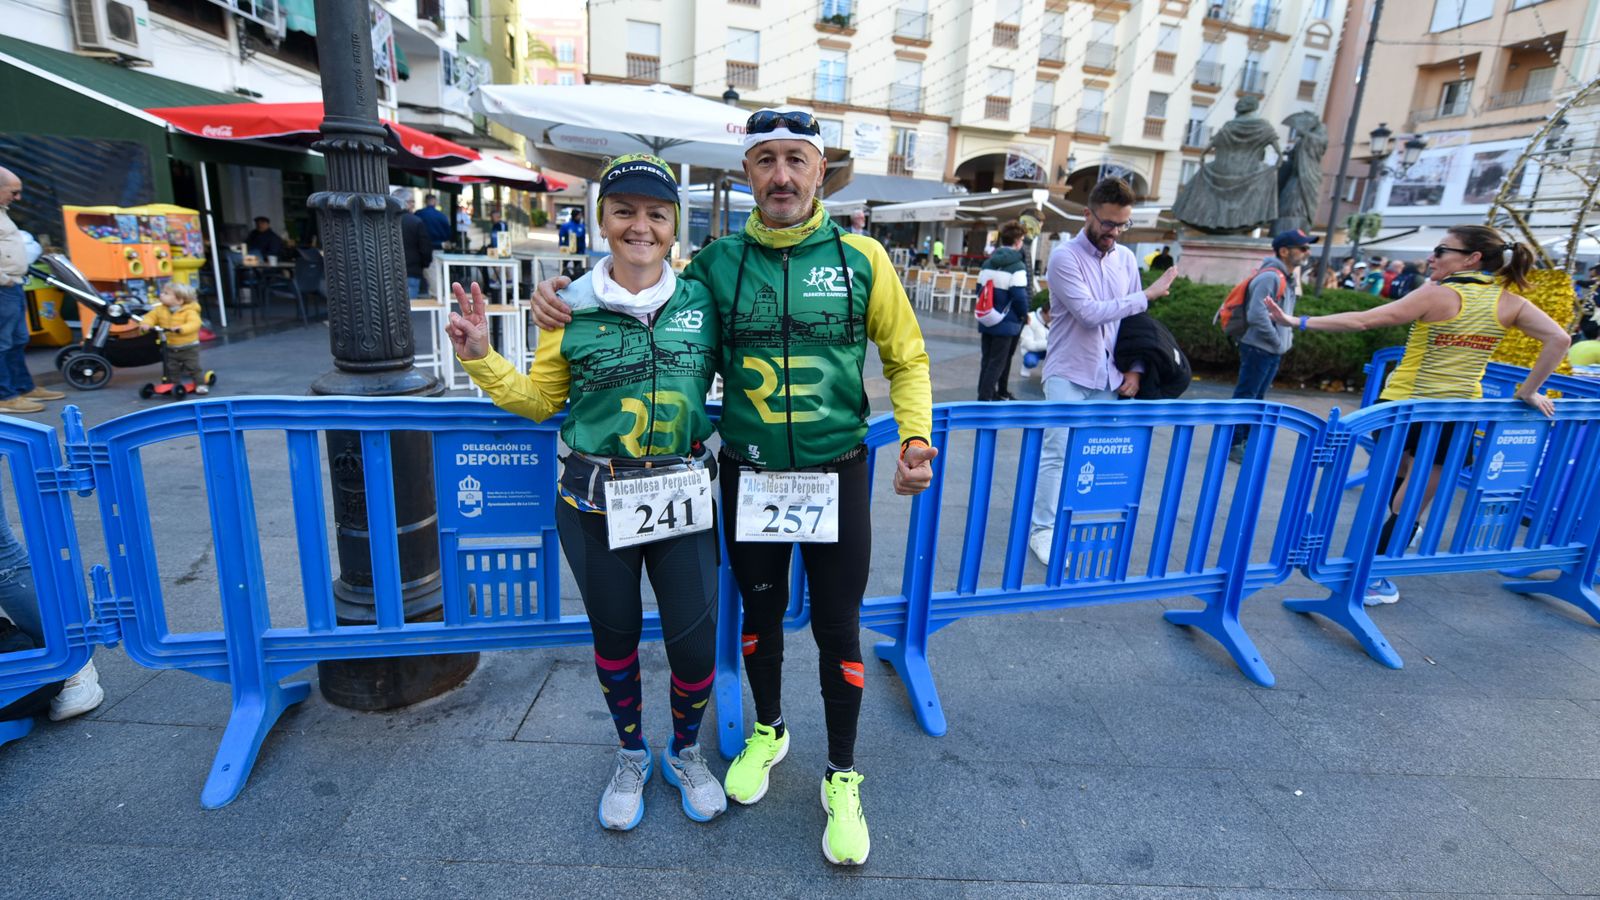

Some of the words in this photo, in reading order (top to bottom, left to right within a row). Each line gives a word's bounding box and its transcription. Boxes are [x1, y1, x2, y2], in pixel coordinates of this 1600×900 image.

[1497, 436, 1537, 445] DEPORTES
[462, 443, 518, 451] DELEGACIÓN
[1082, 445, 1134, 455] DEPORTES
[456, 454, 539, 465] DEPORTES
[635, 497, 697, 534] 241
[762, 504, 824, 534] 257
